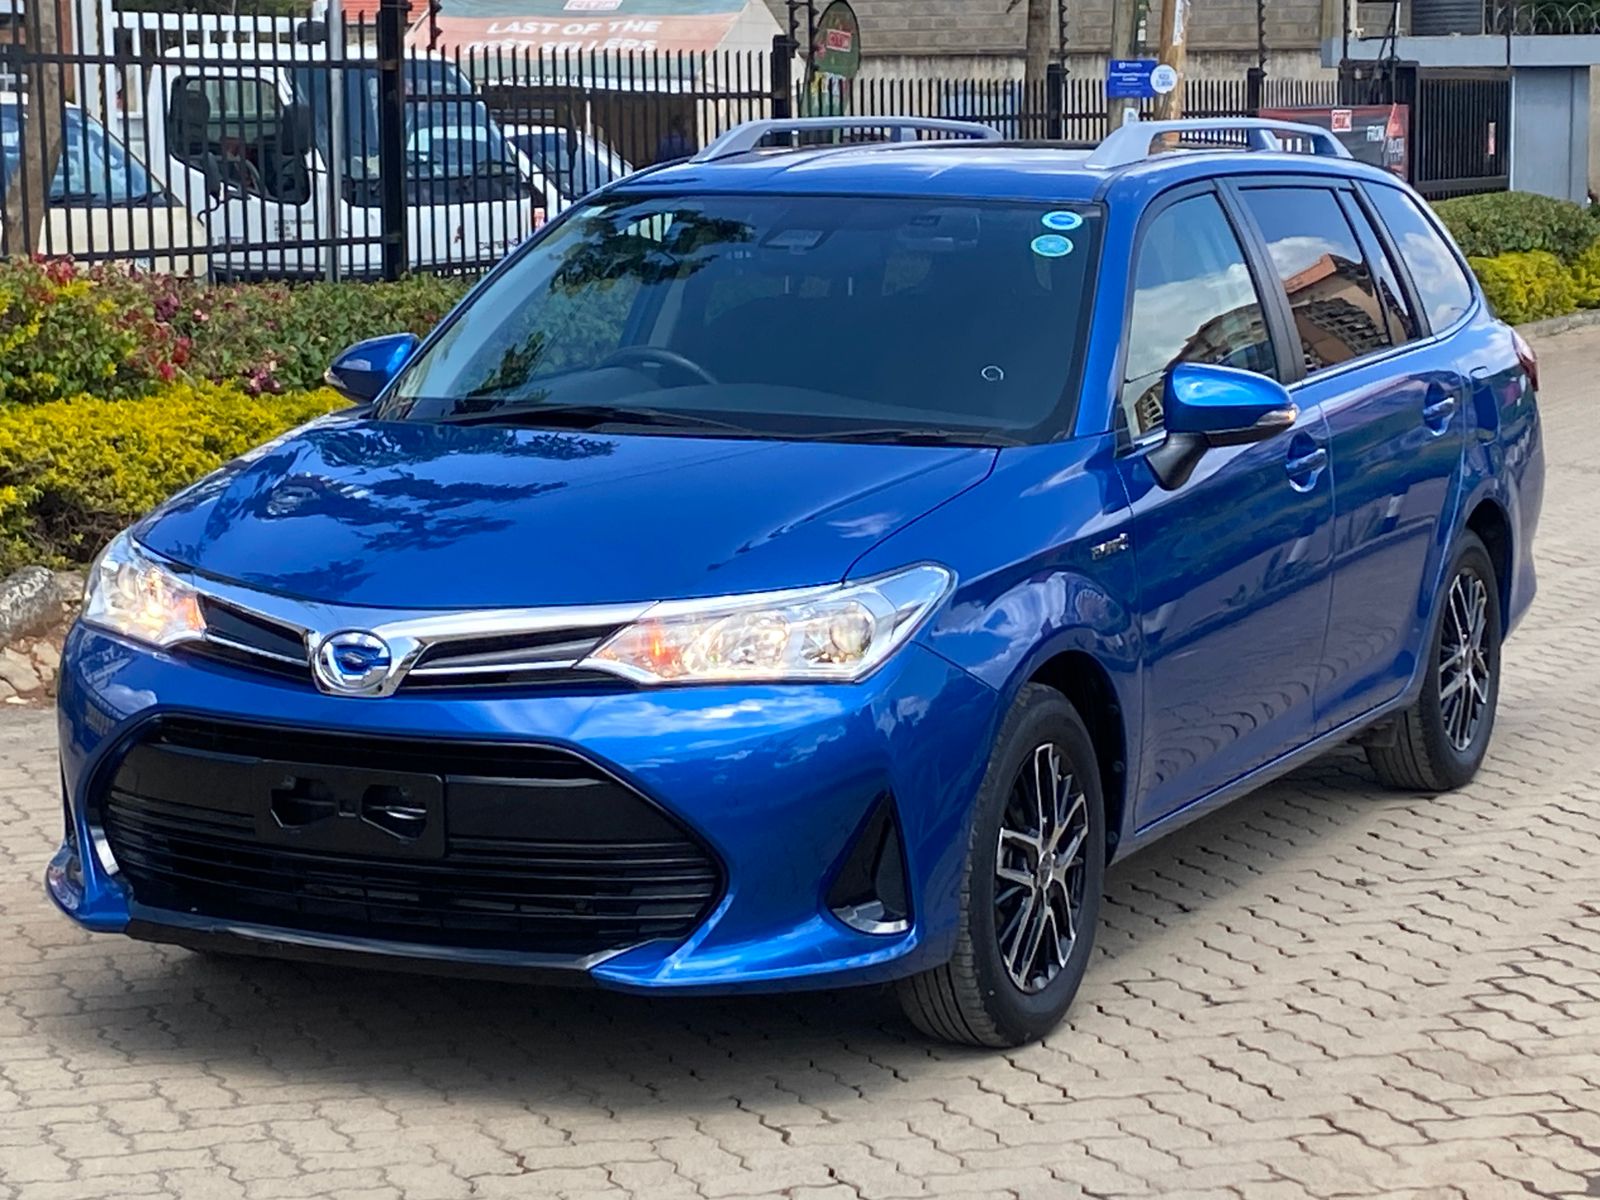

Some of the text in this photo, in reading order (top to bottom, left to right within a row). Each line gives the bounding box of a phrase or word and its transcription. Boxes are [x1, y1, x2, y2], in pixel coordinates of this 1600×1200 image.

[487, 20, 663, 36] LAST OF THE
